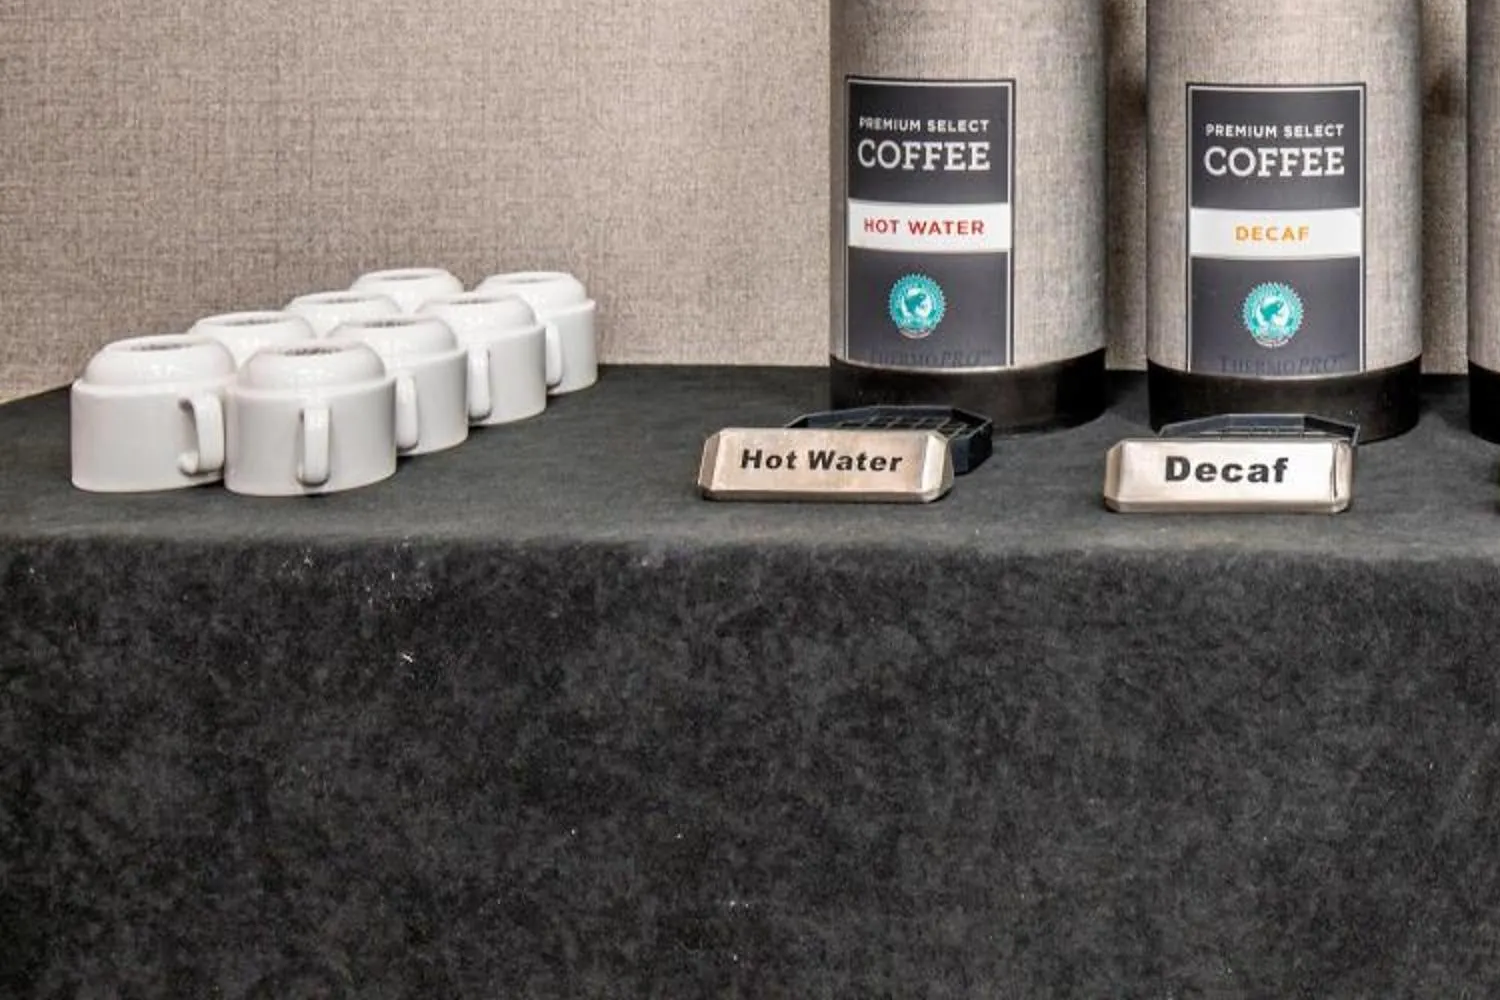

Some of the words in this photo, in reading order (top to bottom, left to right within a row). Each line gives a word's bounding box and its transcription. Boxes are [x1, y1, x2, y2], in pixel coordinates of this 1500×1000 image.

[859, 116, 921, 133] PREMIUM
[927, 118, 990, 133] SELECT
[1205, 123, 1277, 138] PREMIUM
[1284, 123, 1345, 138] SELECT
[857, 138, 991, 172] COFFEE
[1203, 146, 1345, 178] COFFEE
[863, 216, 900, 235] HOT
[907, 219, 985, 236] WATER
[1235, 225, 1310, 242] DECAF
[740, 448, 798, 470] Hot
[808, 449, 903, 472] Water
[1164, 455, 1289, 483] Decaf
